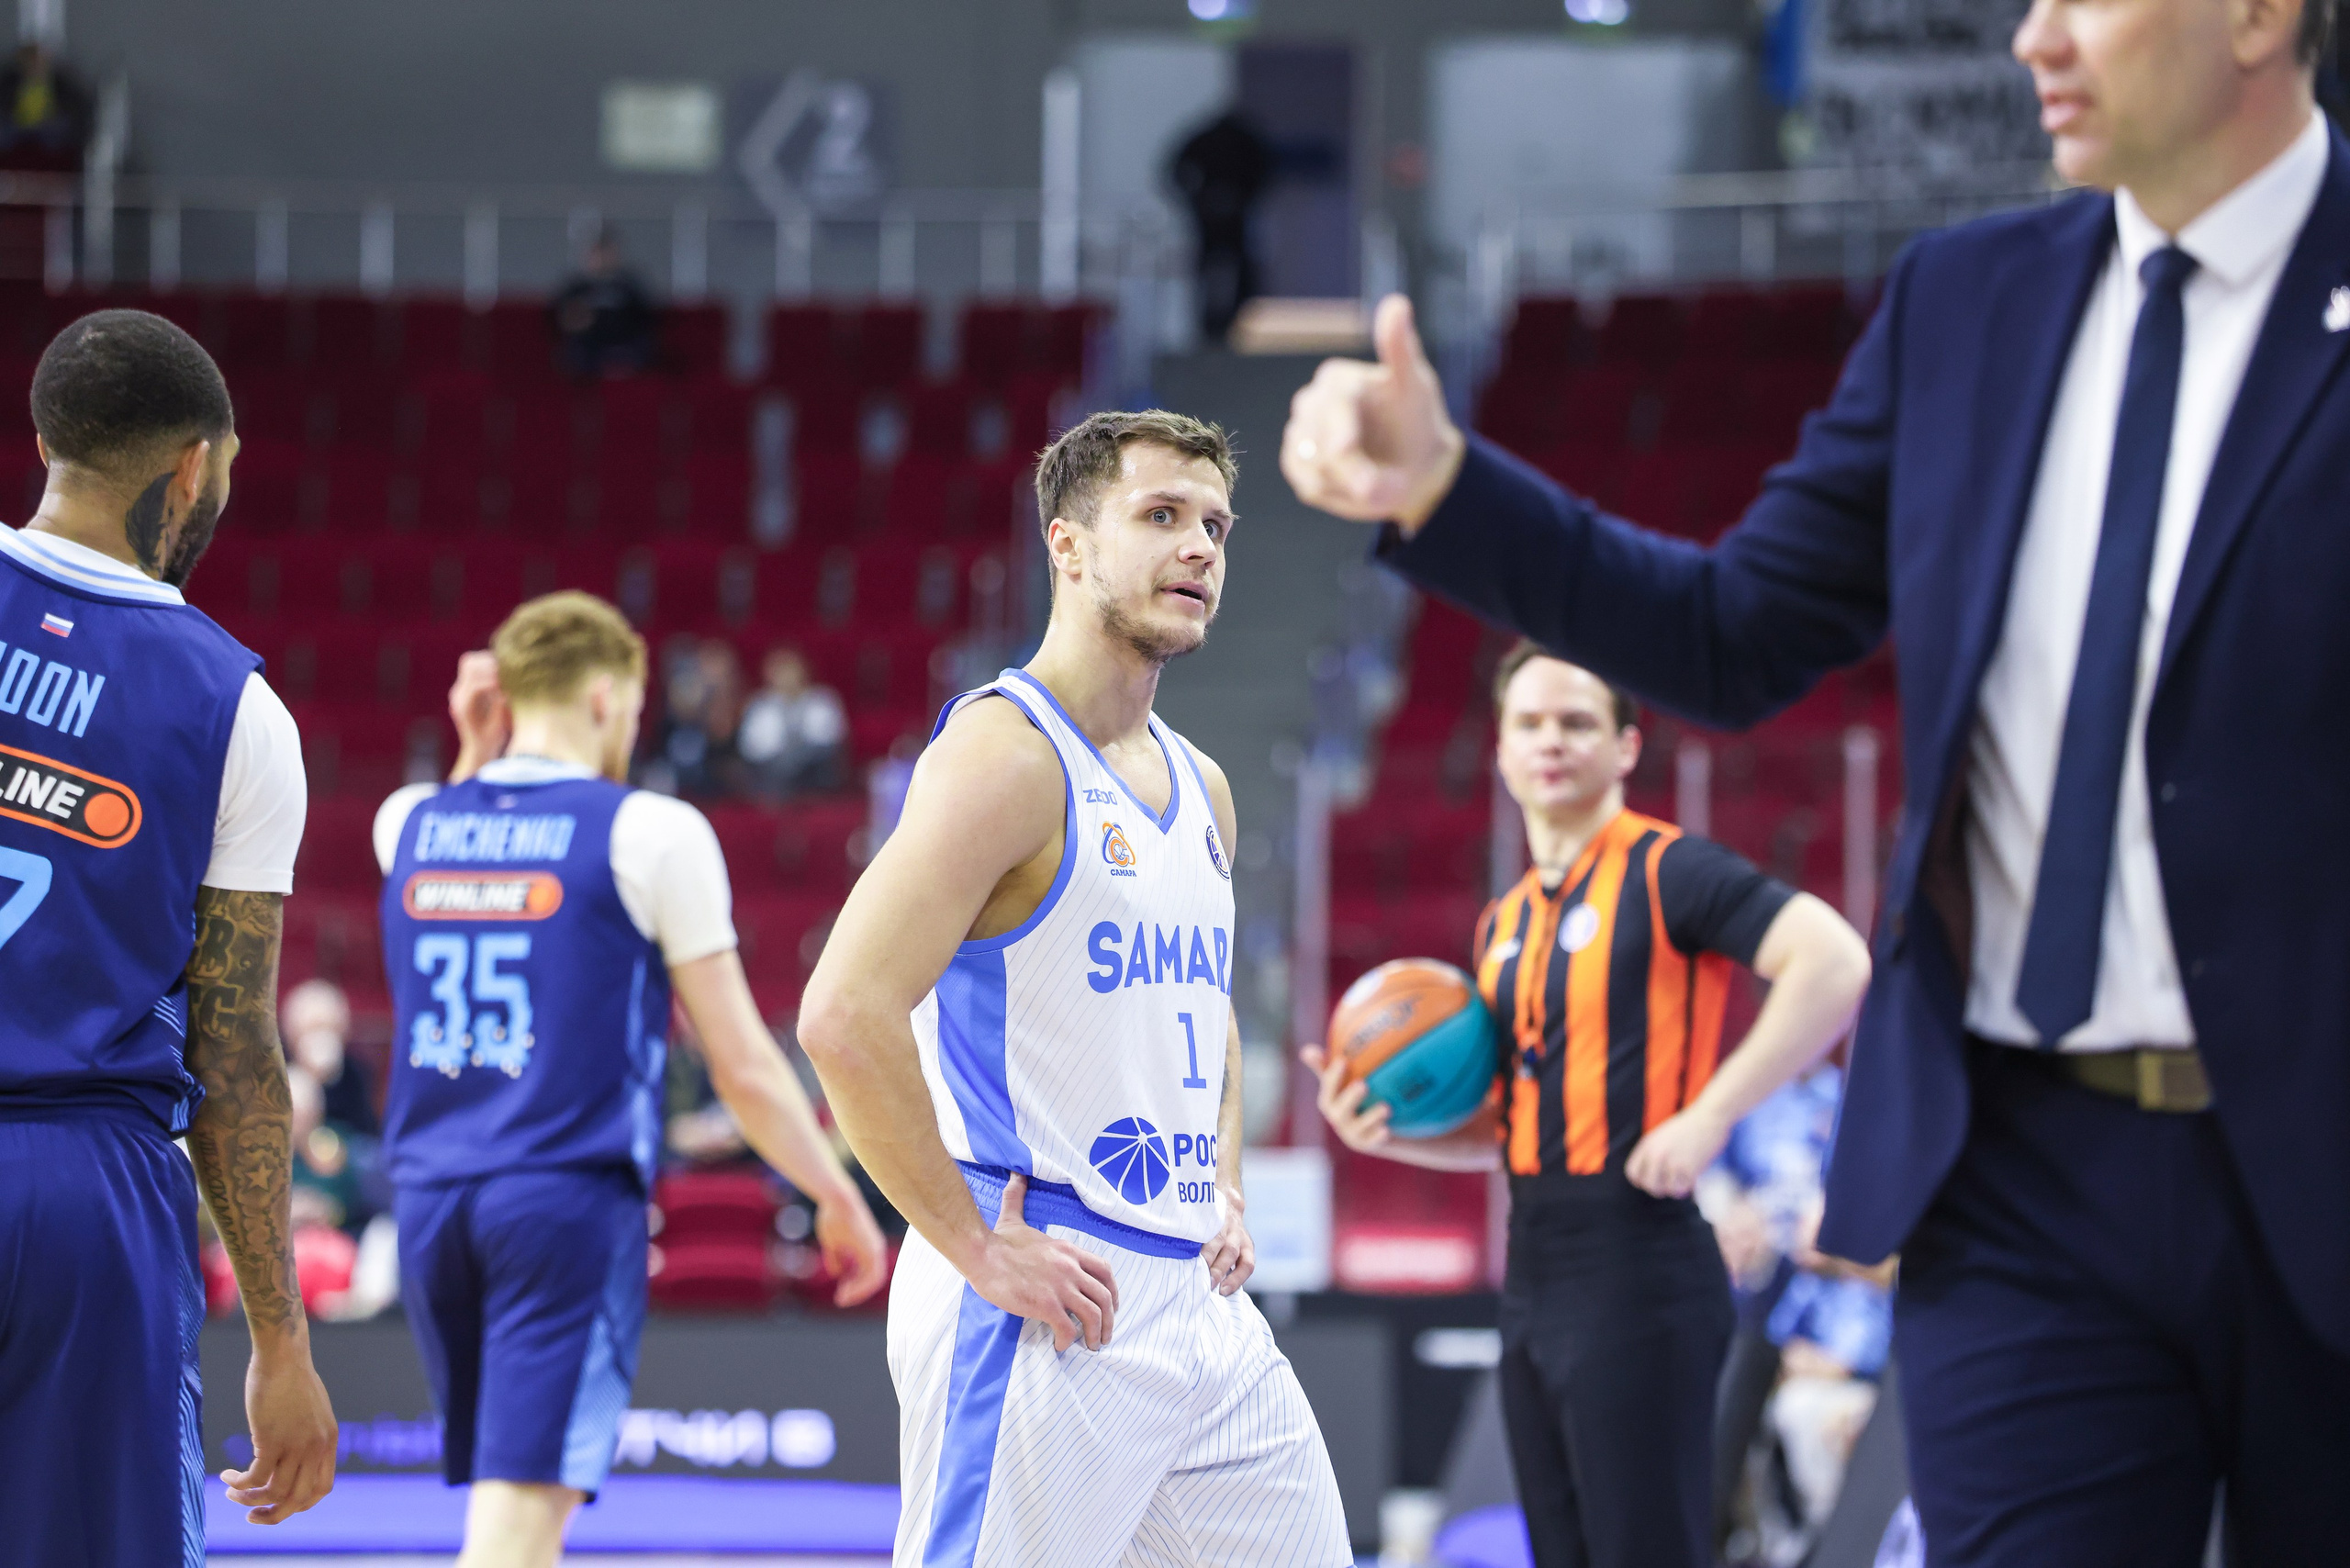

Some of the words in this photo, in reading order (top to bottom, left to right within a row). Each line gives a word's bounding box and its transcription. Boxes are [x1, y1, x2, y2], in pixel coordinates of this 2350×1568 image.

[0, 640, 106, 738] DON
[0, 760, 85, 819] INE
[414, 880, 526, 912] WINLINE
[410, 932, 532, 1072] 35
[1177, 1012, 1207, 1089] 1
